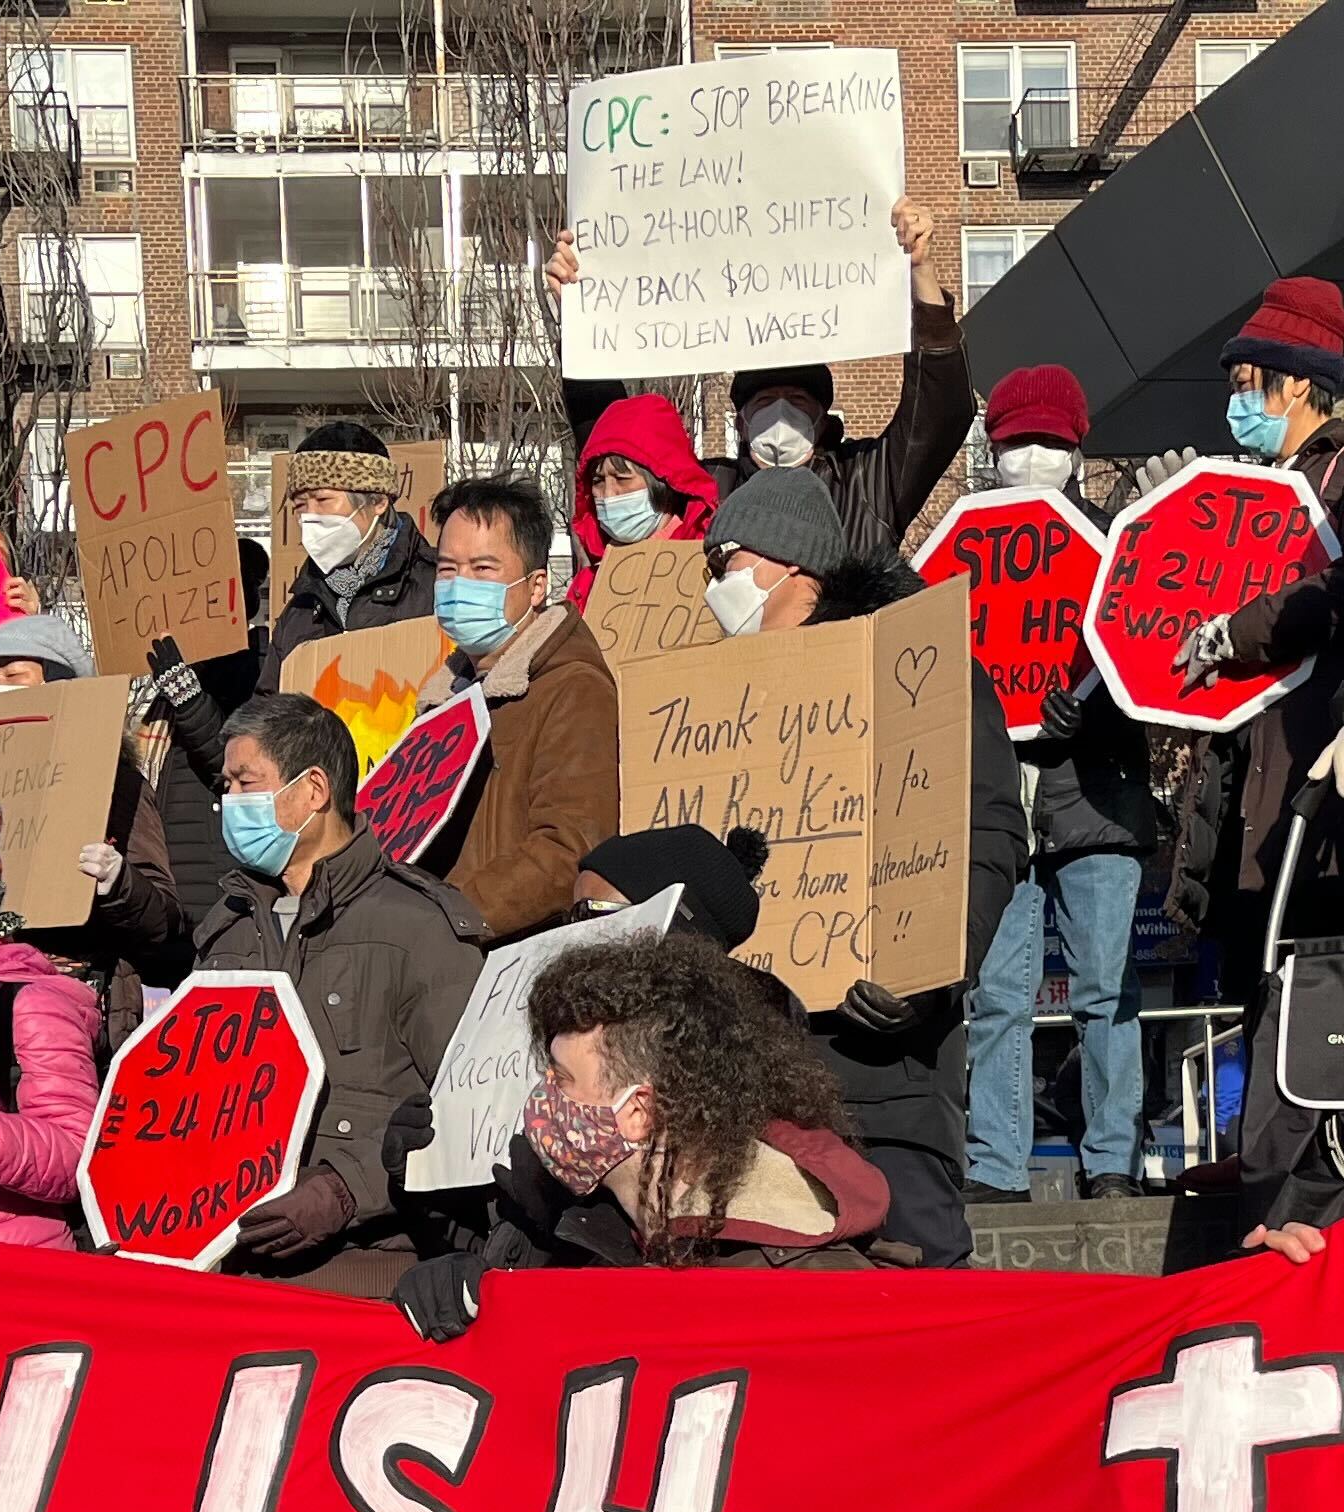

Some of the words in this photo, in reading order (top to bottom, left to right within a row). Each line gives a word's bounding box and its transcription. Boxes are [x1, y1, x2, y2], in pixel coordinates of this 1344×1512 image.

[582, 94, 670, 152] CPC:
[690, 86, 750, 137] STOP
[766, 72, 897, 125] BREAKING
[611, 160, 665, 192] THE
[679, 150, 744, 188] LAW!
[576, 212, 630, 252] END
[642, 205, 753, 247] 24-HOUR
[766, 193, 869, 235] SHIFTS!
[579, 274, 629, 313] PAY
[636, 268, 706, 306] BACK
[721, 259, 770, 297] $90
[779, 253, 878, 291] MILLION
[592, 322, 618, 351] IN
[634, 316, 731, 351] STOLEN
[746, 303, 840, 346] WAGES!
[84, 410, 218, 521] CPC
[1190, 488, 1311, 554] STOP
[98, 526, 217, 600] APOLO
[609, 550, 707, 599] CPC
[953, 520, 1071, 591] STOP
[1156, 551, 1225, 599] 24
[1236, 561, 1310, 608] HR
[598, 601, 717, 652] STOP
[1021, 598, 1083, 645] HR
[989, 661, 1075, 697] RKDAY
[370, 723, 466, 800] STOP
[649, 682, 758, 763] Thank
[779, 692, 870, 785] you,
[648, 784, 704, 831] AM
[752, 876, 781, 899] or
[792, 843, 849, 900] home
[789, 903, 880, 969] CPC
[144, 986, 283, 1078] STOP
[432, 1042, 530, 1099] Racial
[96, 1092, 129, 1150] THE
[134, 1091, 200, 1143] 24
[211, 1063, 277, 1142] HR
[114, 1139, 284, 1242] WORKDAY
